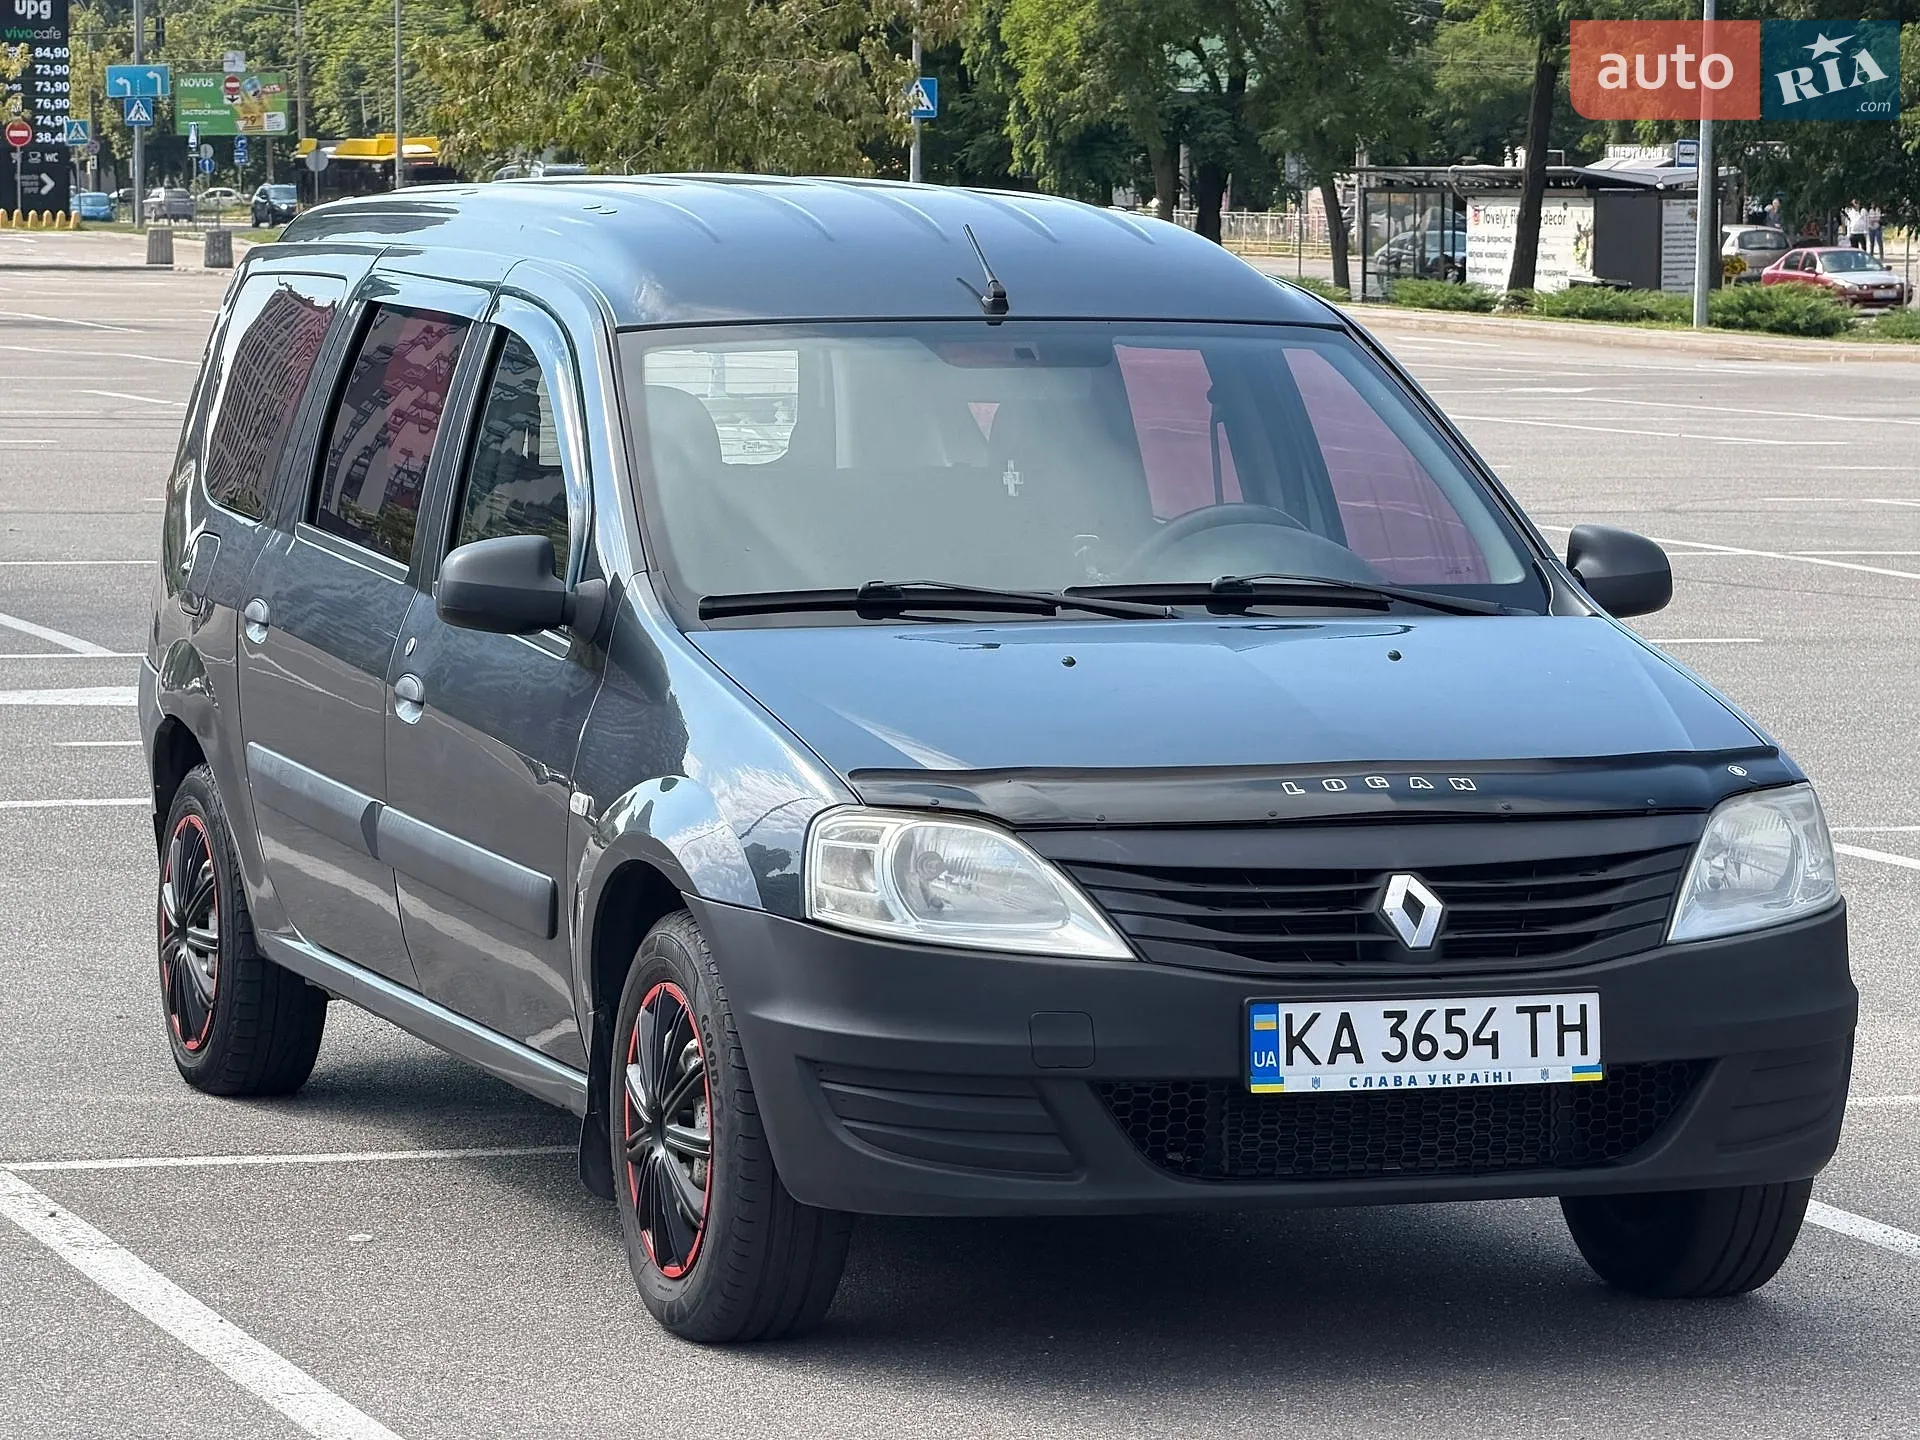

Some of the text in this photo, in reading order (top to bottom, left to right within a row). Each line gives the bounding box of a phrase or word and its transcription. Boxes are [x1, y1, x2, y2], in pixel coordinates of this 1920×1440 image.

[35, 47, 70, 59] 84,90
[35, 64, 70, 77] 73,90
[35, 81, 70, 94] 73,90
[180, 78, 214, 88] NOVUS
[35, 98, 70, 110] 76,90
[35, 132, 66, 144] 38,4
[44, 152, 59, 163] WC
[1280, 775, 1478, 796] LOGAN
[1285, 1003, 1588, 1066] KA 3654 TH
[1254, 1051, 1278, 1068] UA
[1349, 1070, 1513, 1089] СЛАВА УКРАЇНІ
